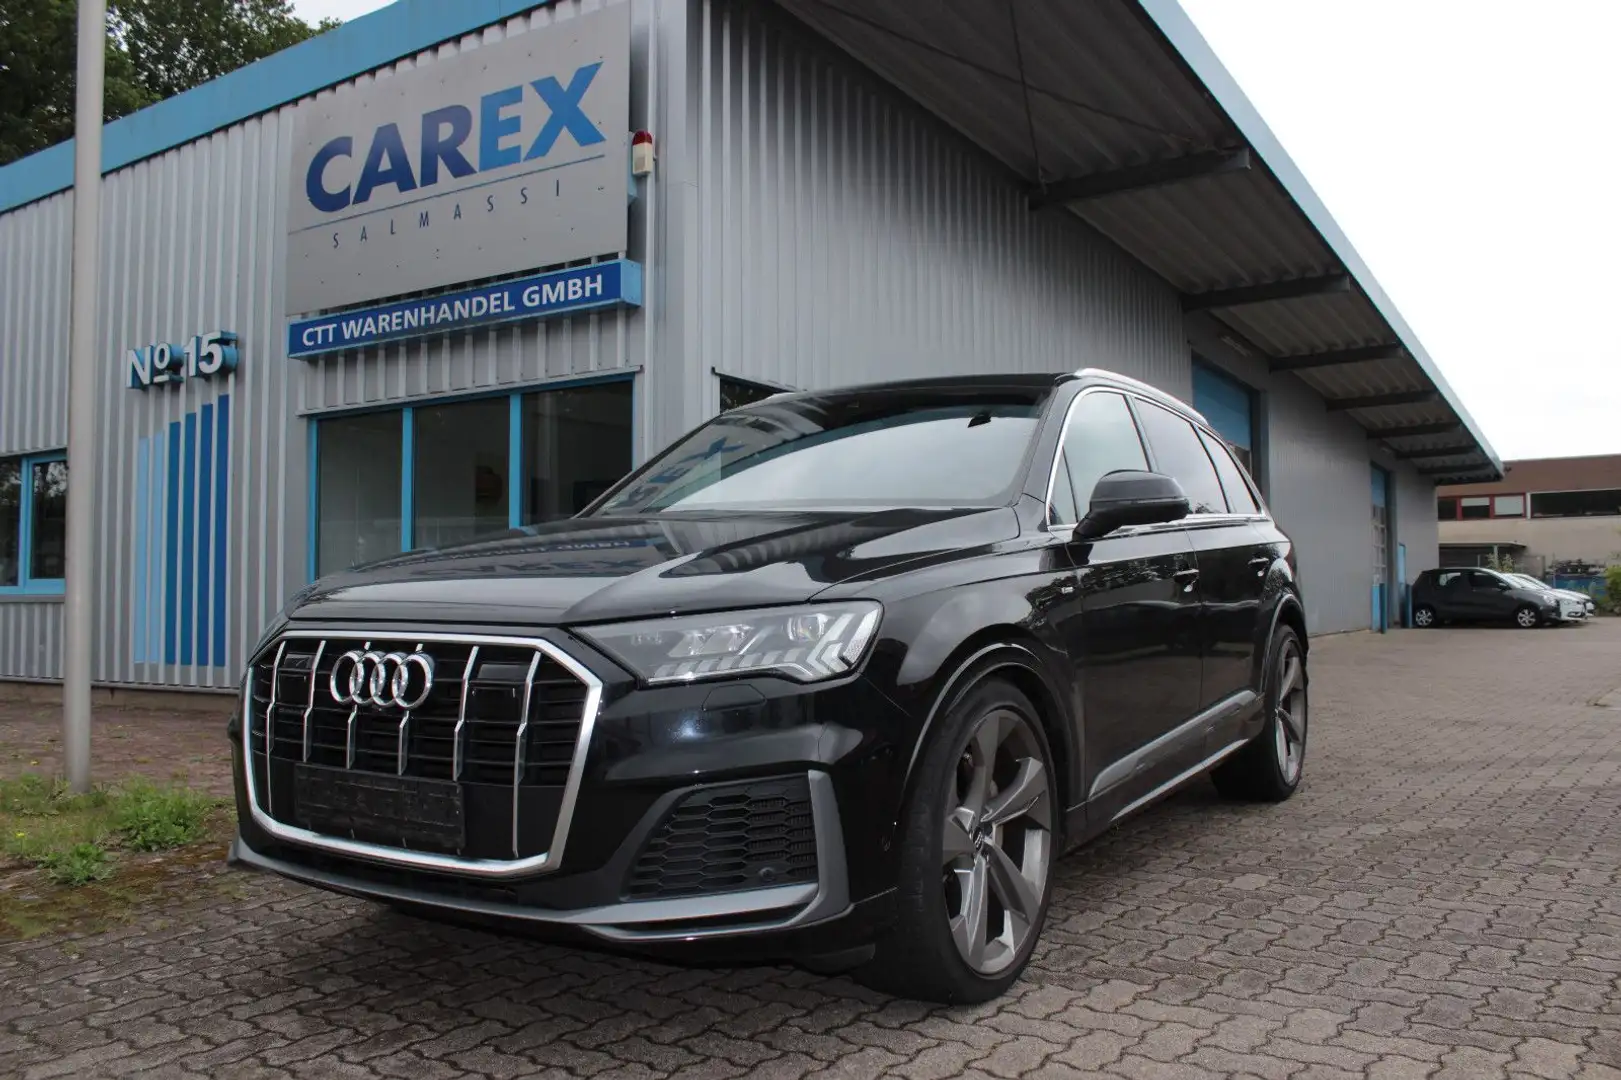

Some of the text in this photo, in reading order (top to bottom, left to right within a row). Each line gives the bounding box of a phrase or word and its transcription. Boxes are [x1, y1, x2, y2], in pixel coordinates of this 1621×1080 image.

[305, 61, 608, 213] CAREX
[332, 179, 561, 249] SALMASSI
[302, 273, 603, 347] CTT WARENHANDEL GMBH
[183, 330, 226, 378] 15
